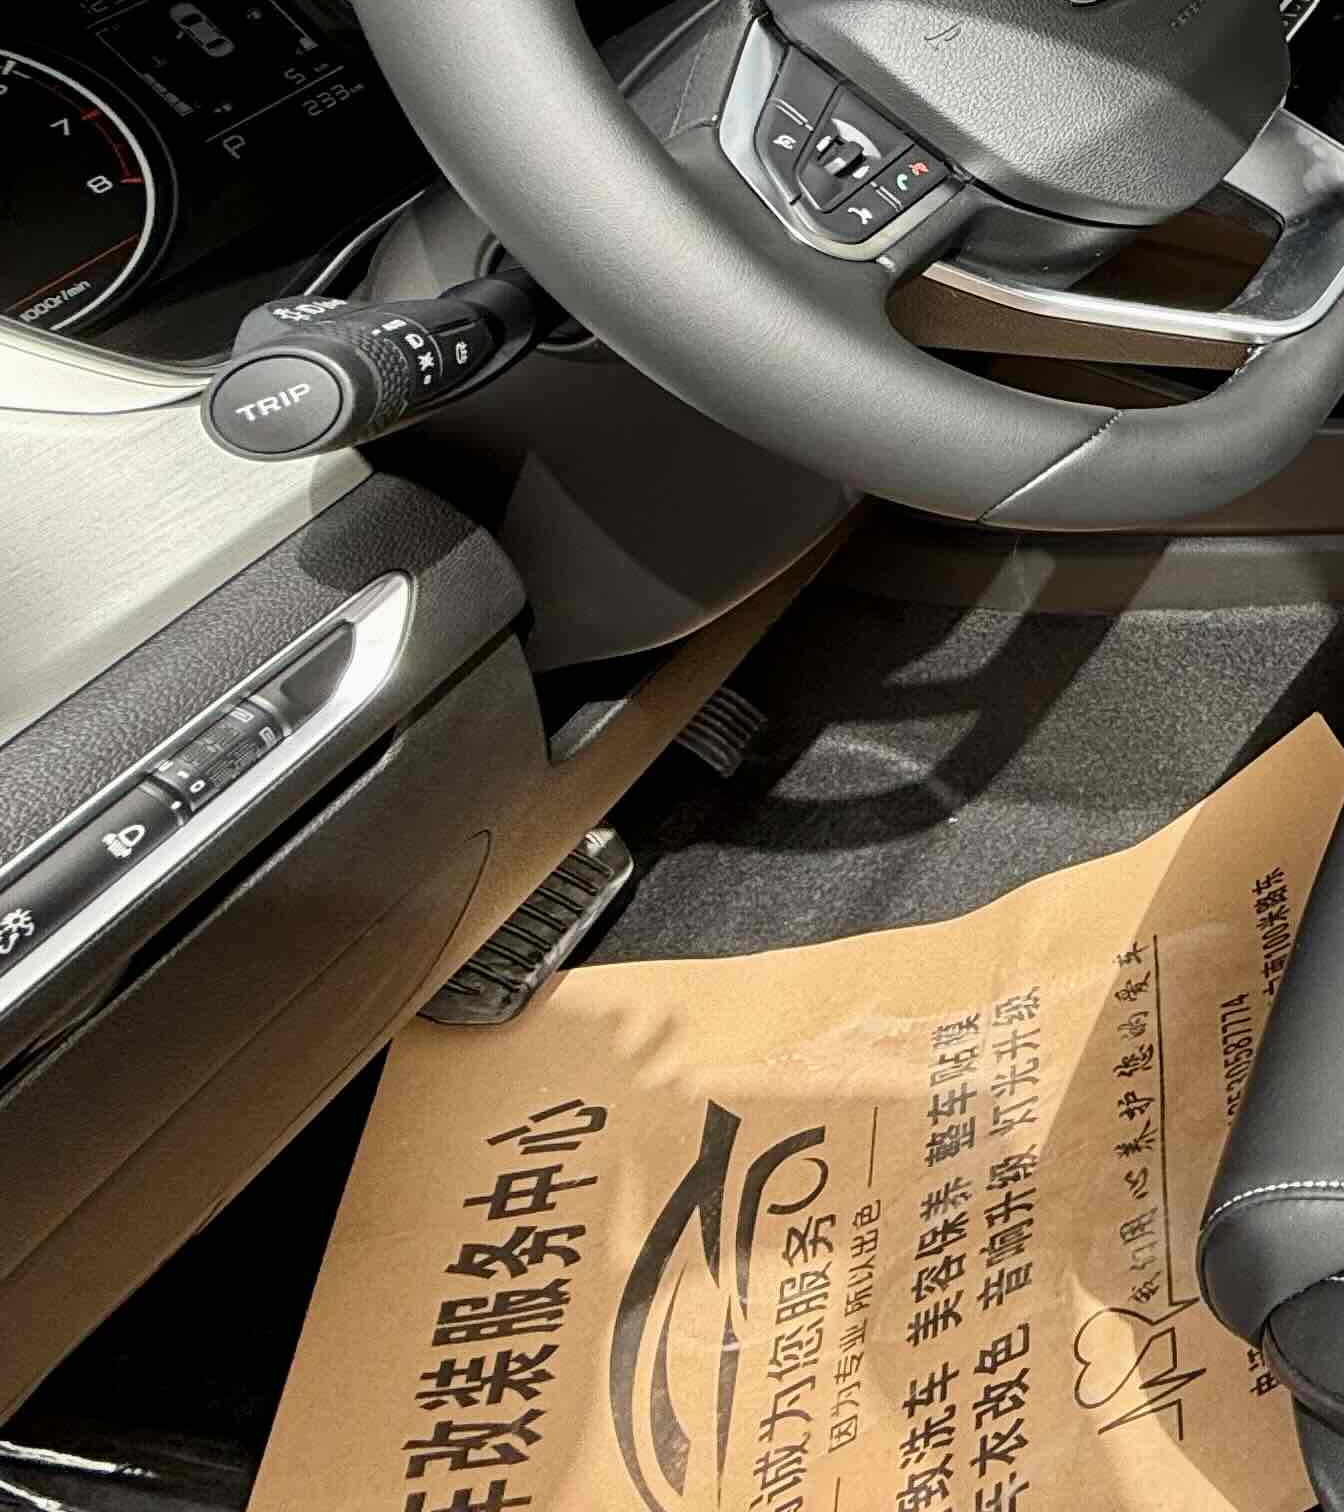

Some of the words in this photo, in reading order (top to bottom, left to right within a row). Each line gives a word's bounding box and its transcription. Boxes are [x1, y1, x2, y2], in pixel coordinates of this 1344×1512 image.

[49, 117, 73, 137] 7
[85, 174, 115, 195] 8
[235, 381, 312, 422] TRIP
[924, 1013, 981, 1168] 整车贴膜
[988, 985, 1041, 1137] 灯光升级
[906, 1176, 974, 1348] 美容保养
[976, 1143, 1038, 1312] 音响升级
[748, 1213, 837, 1512] 诚为您服务
[896, 1361, 960, 1512] 致洗车
